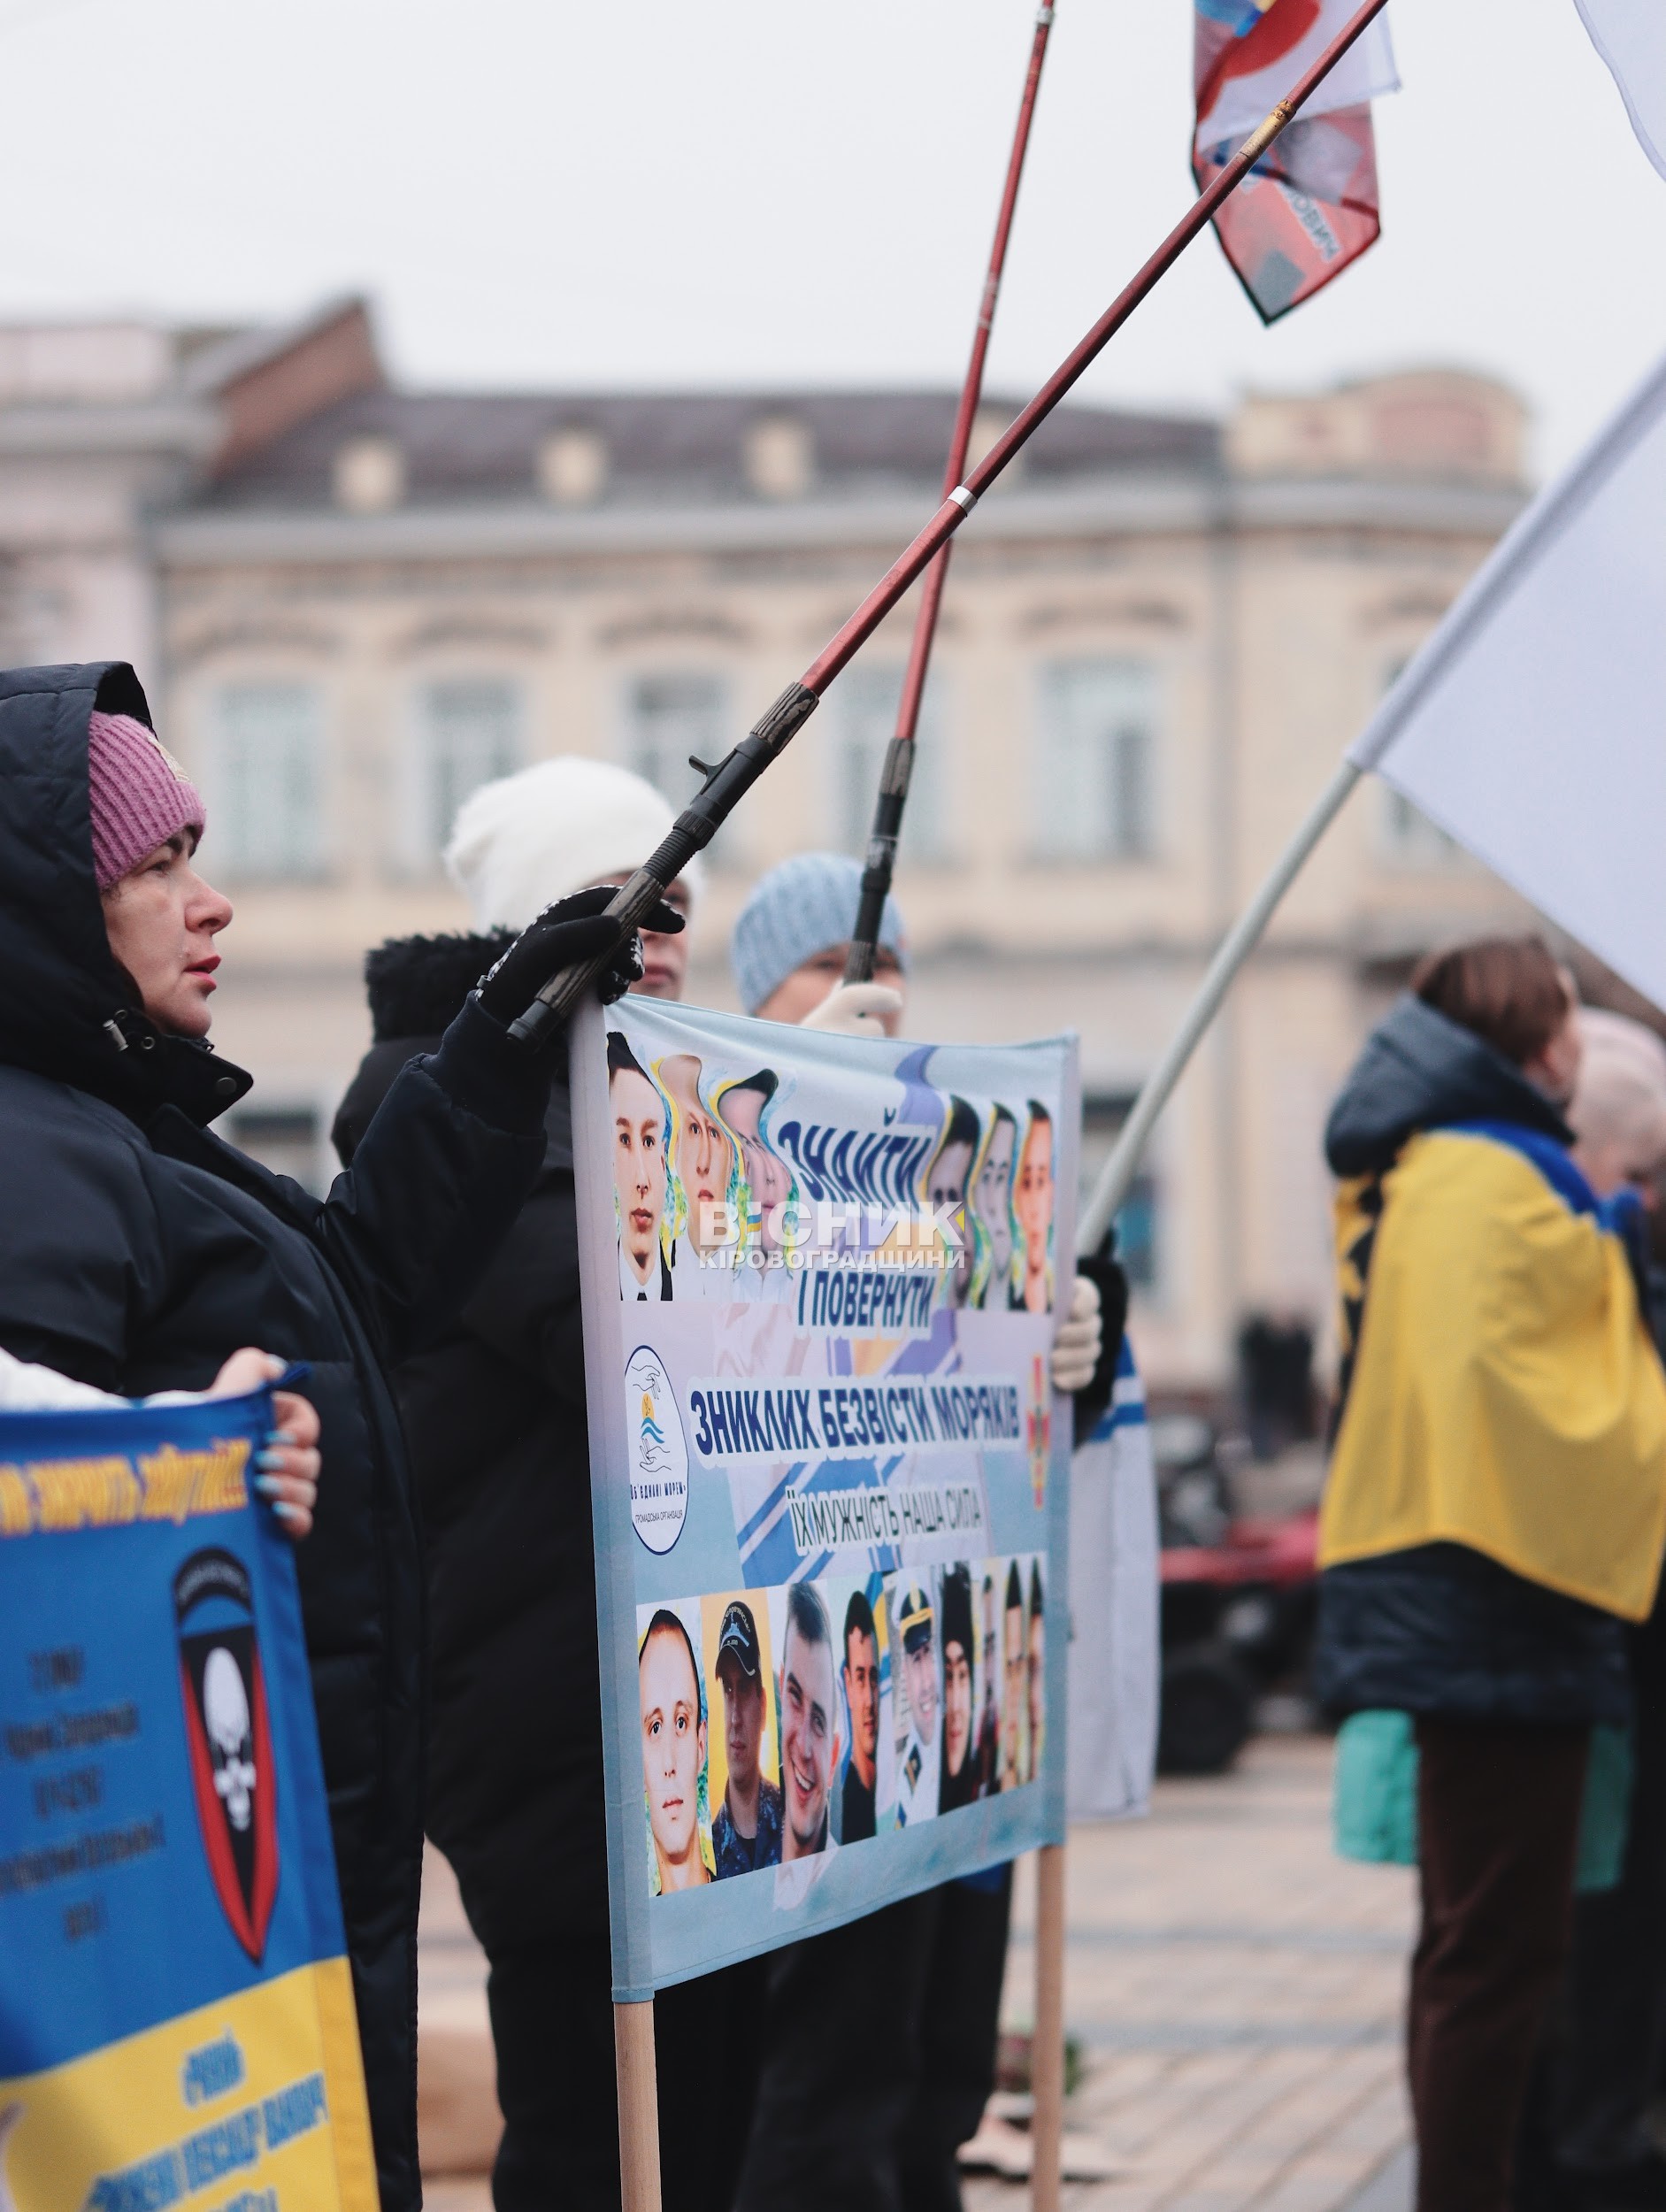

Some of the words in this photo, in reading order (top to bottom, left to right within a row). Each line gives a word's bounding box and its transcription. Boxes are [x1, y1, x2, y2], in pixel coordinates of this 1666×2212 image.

[778, 1108, 932, 1214] ЗНАЙТИ
[798, 1269, 808, 1326] І
[812, 1270, 935, 1328] ПОВЕРНУТИ
[690, 1389, 819, 1455] ЗНИКЛИХ
[818, 1386, 936, 1448] БЕЗВІСТИ
[931, 1385, 1019, 1442] МОРЯКІВ
[634, 1511, 660, 1524] ГРОМАДСЬКА
[660, 1509, 683, 1521] ОРГАНІЗАЦІЯ
[787, 1489, 810, 1548] ЇХ
[813, 1494, 899, 1544] МУЖНІСТЬ
[903, 1490, 946, 1535] НАША
[947, 1487, 981, 1530] СИЛА
